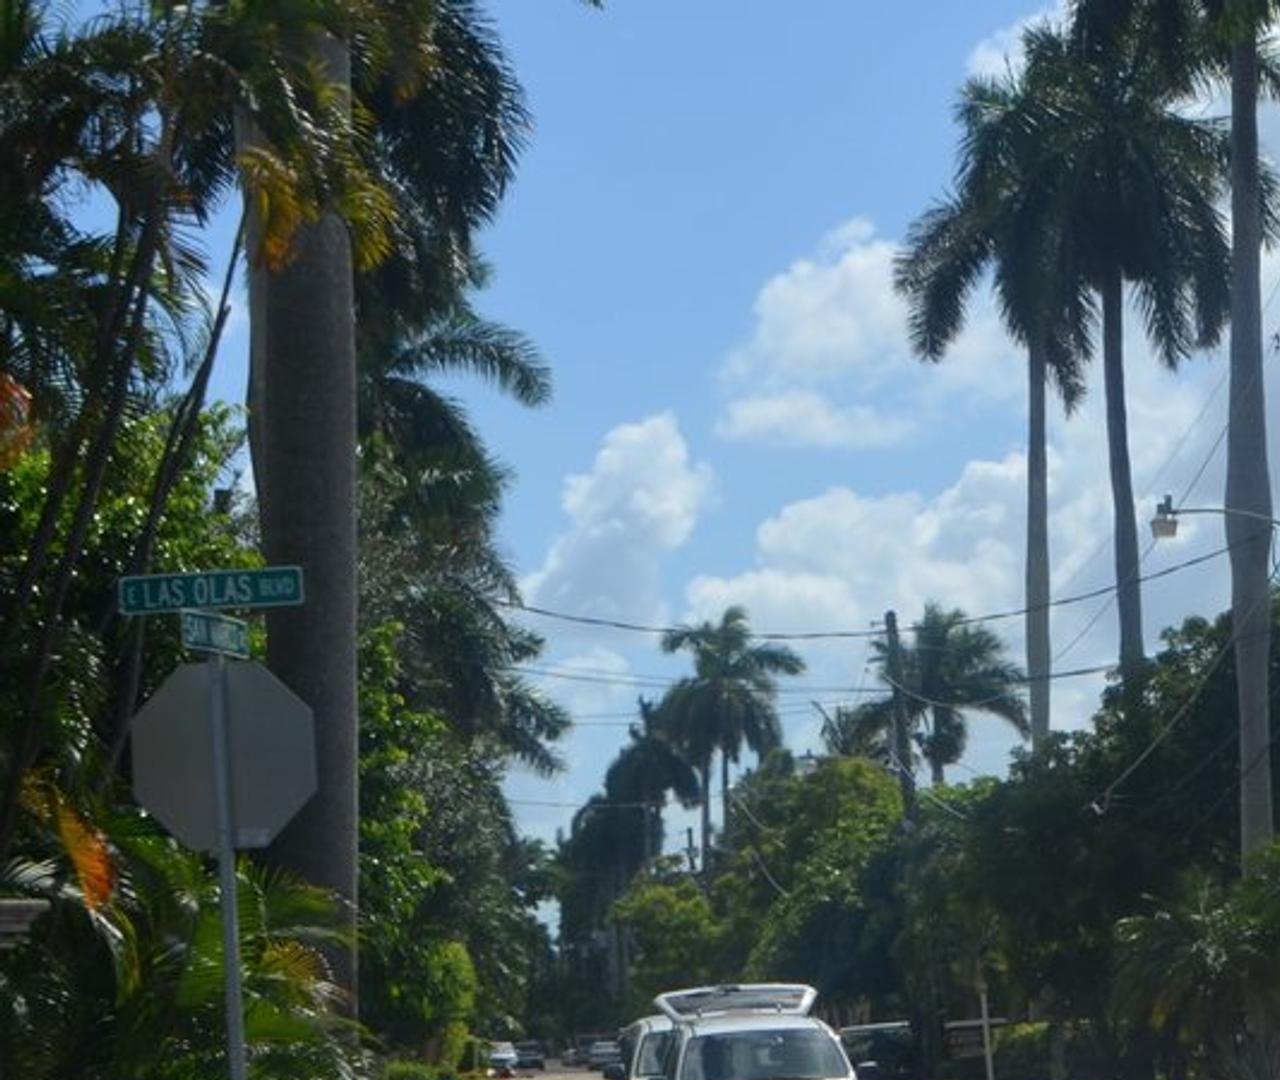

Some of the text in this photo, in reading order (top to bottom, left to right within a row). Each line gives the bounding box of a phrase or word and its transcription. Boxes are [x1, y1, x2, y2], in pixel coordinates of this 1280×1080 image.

[143, 579, 185, 607] LAS
[194, 576, 253, 604] OLAS
[259, 576, 294, 597] BLVD
